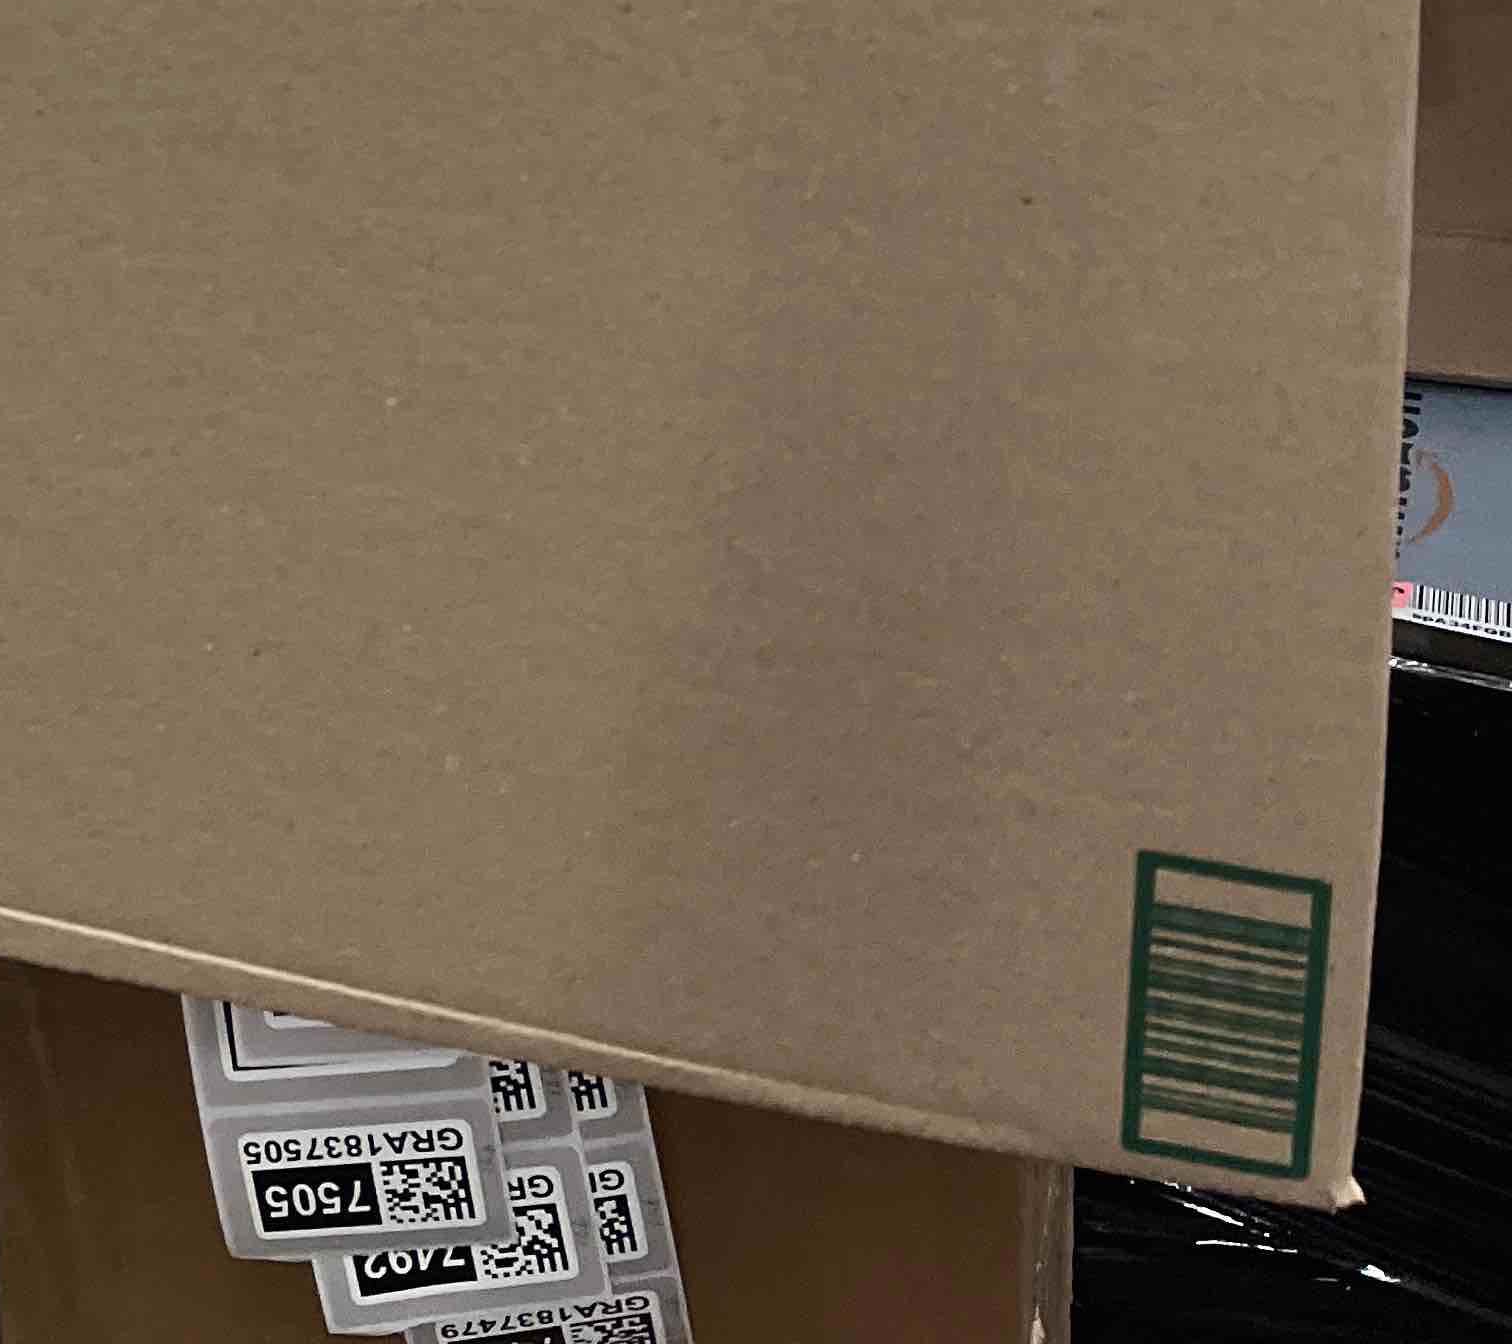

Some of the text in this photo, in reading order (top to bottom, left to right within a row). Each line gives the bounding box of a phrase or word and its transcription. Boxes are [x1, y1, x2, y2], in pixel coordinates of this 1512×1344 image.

[243, 1127, 464, 1165] GRA1837505
[264, 1180, 371, 1218] 7505
[440, 1295, 651, 1340] GRA1837479
